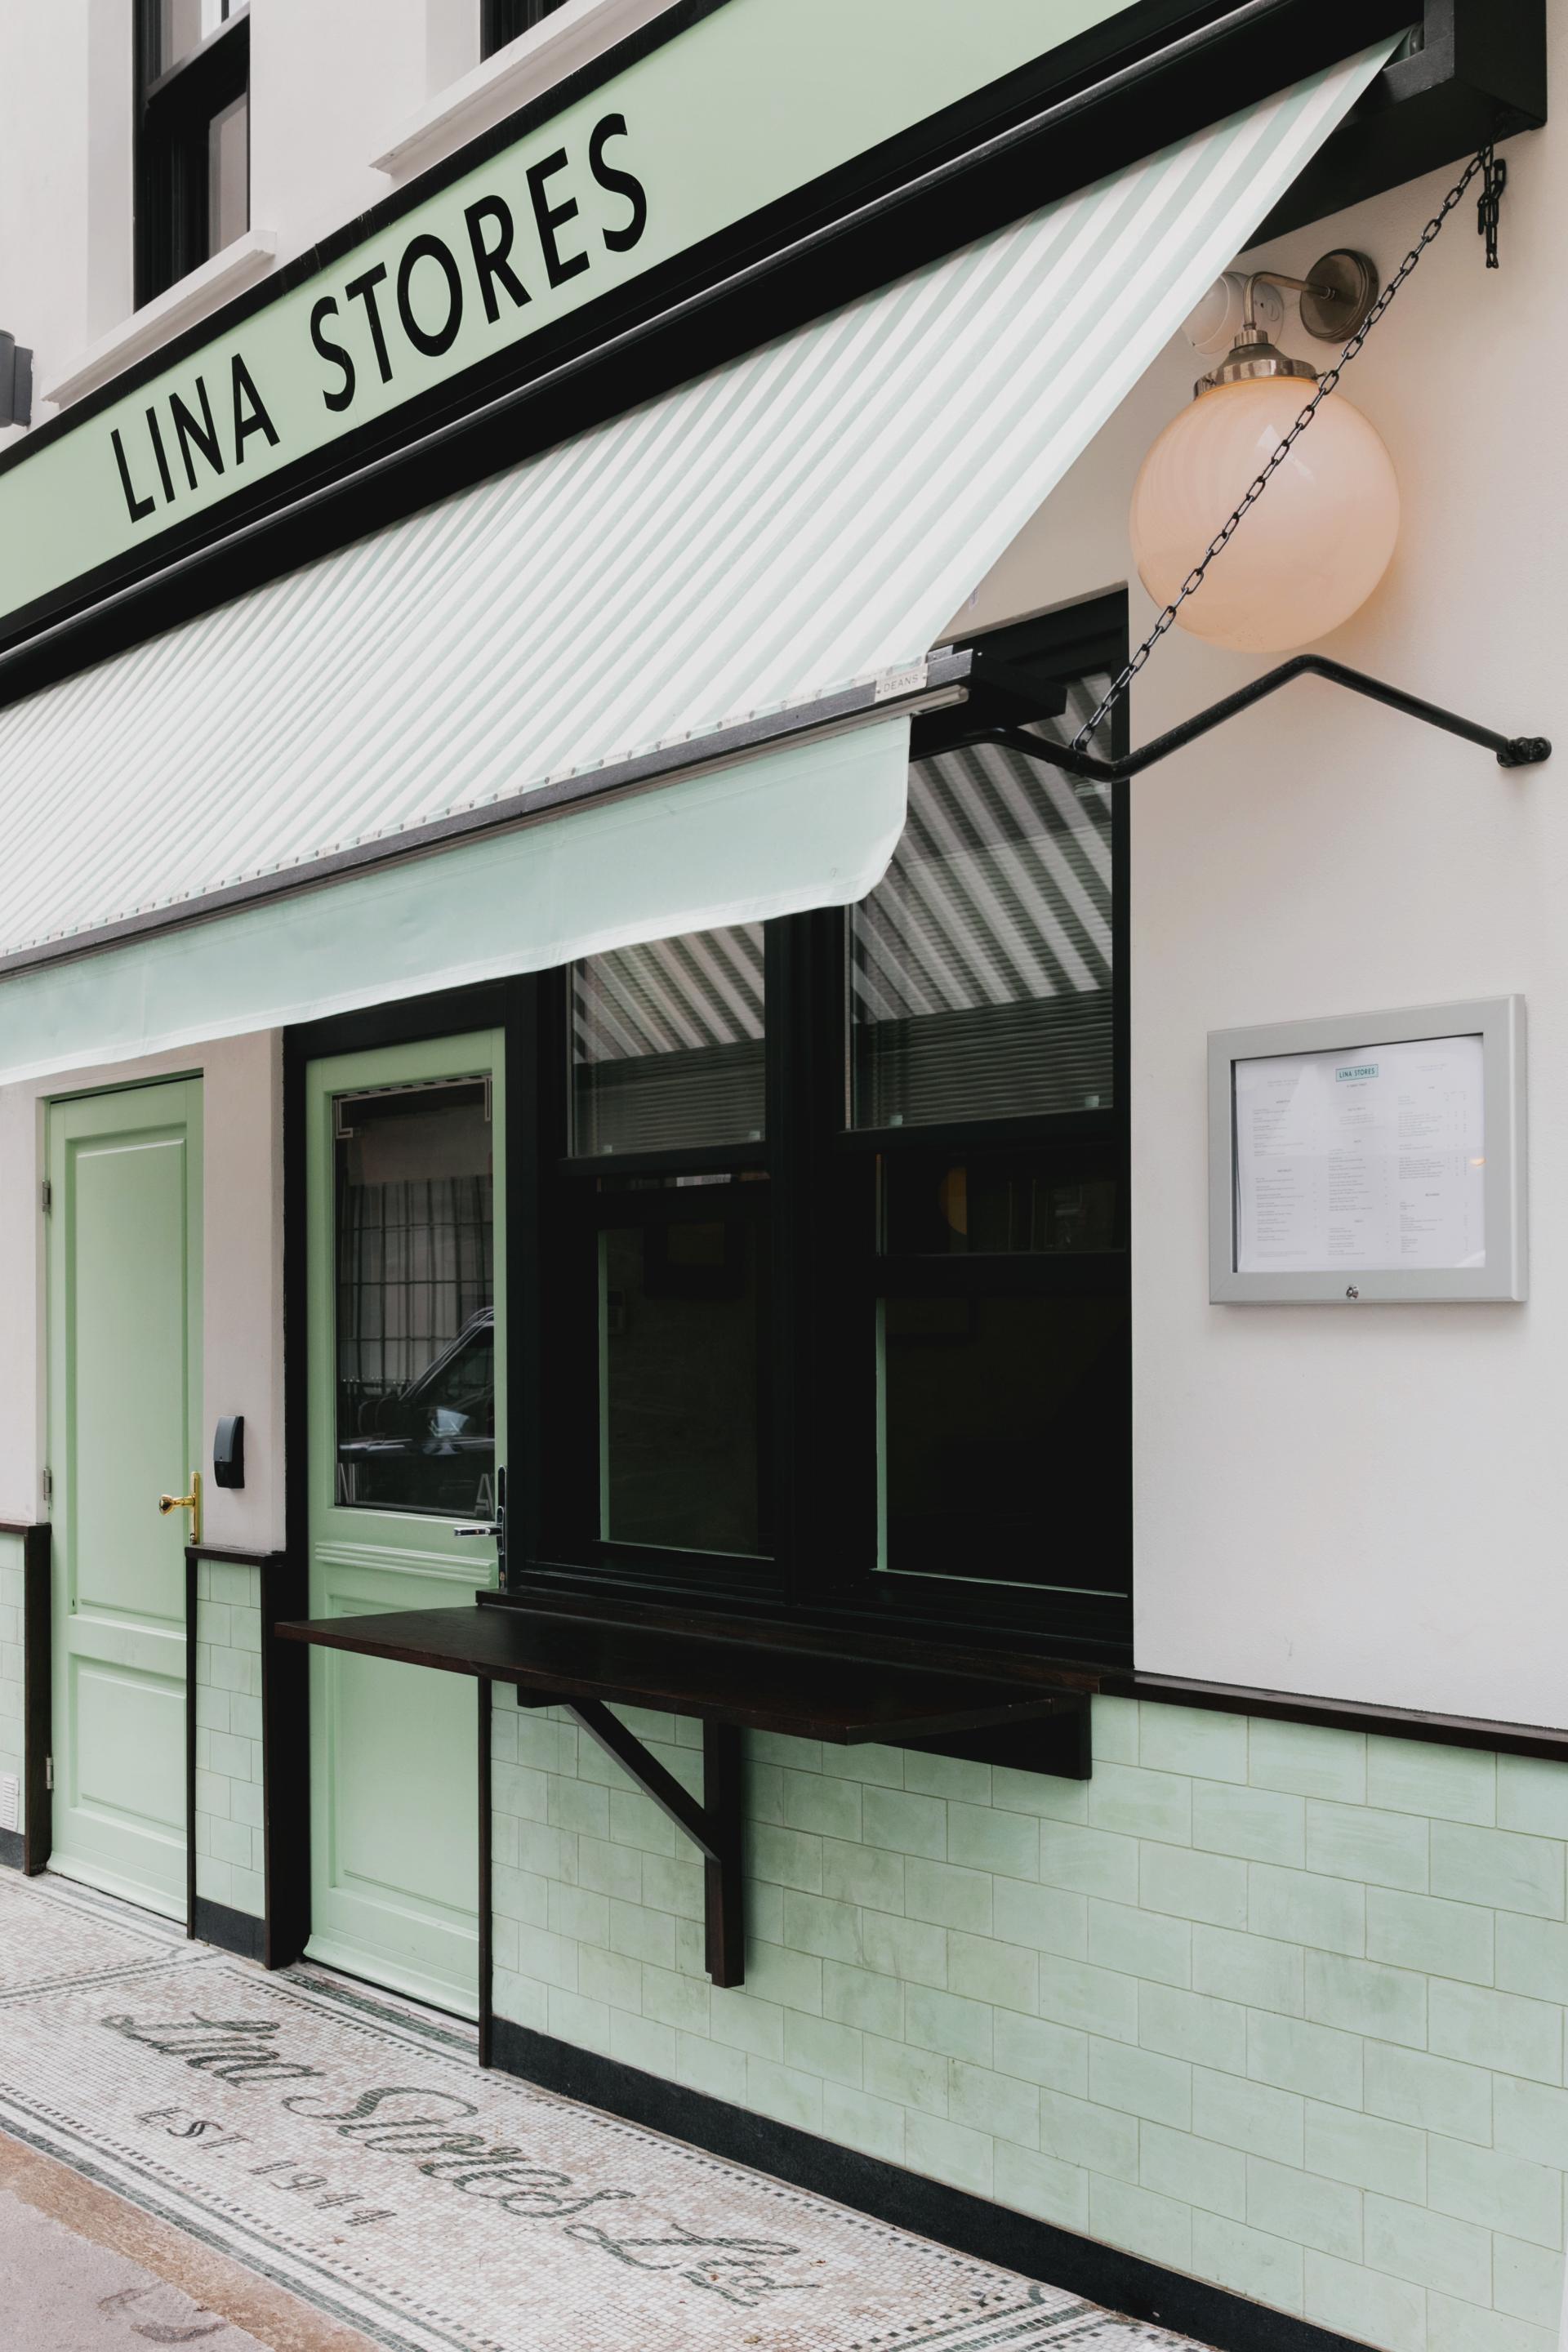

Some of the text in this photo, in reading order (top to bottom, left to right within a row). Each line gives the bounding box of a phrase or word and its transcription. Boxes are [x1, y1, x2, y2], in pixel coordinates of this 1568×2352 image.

[110, 113, 647, 523] LINA STORES
[884, 675, 919, 692] DEANS
[1339, 1067, 1375, 1079] LINA STORES
[100, 2011, 328, 2091] Lina
[282, 2087, 636, 2217] Stores
[135, 2106, 398, 2227] EST. 1944
